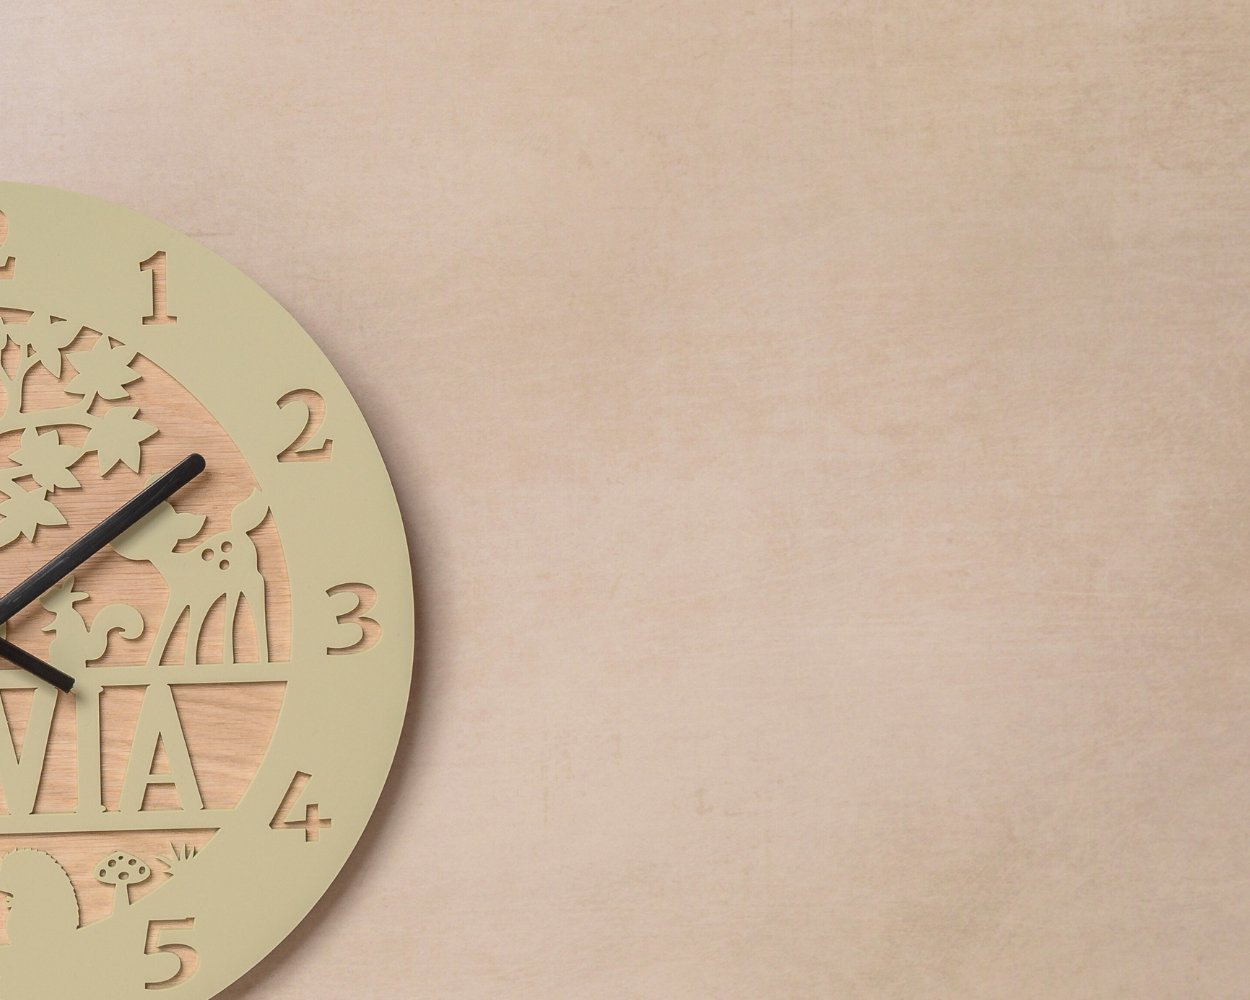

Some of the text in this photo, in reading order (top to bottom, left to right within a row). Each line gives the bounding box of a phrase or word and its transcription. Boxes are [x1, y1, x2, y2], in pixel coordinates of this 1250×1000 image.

[139, 250, 178, 326] 1
[275, 388, 334, 463] 2
[325, 582, 383, 656] 3
[268, 770, 332, 843] 4
[143, 916, 200, 991] 5
